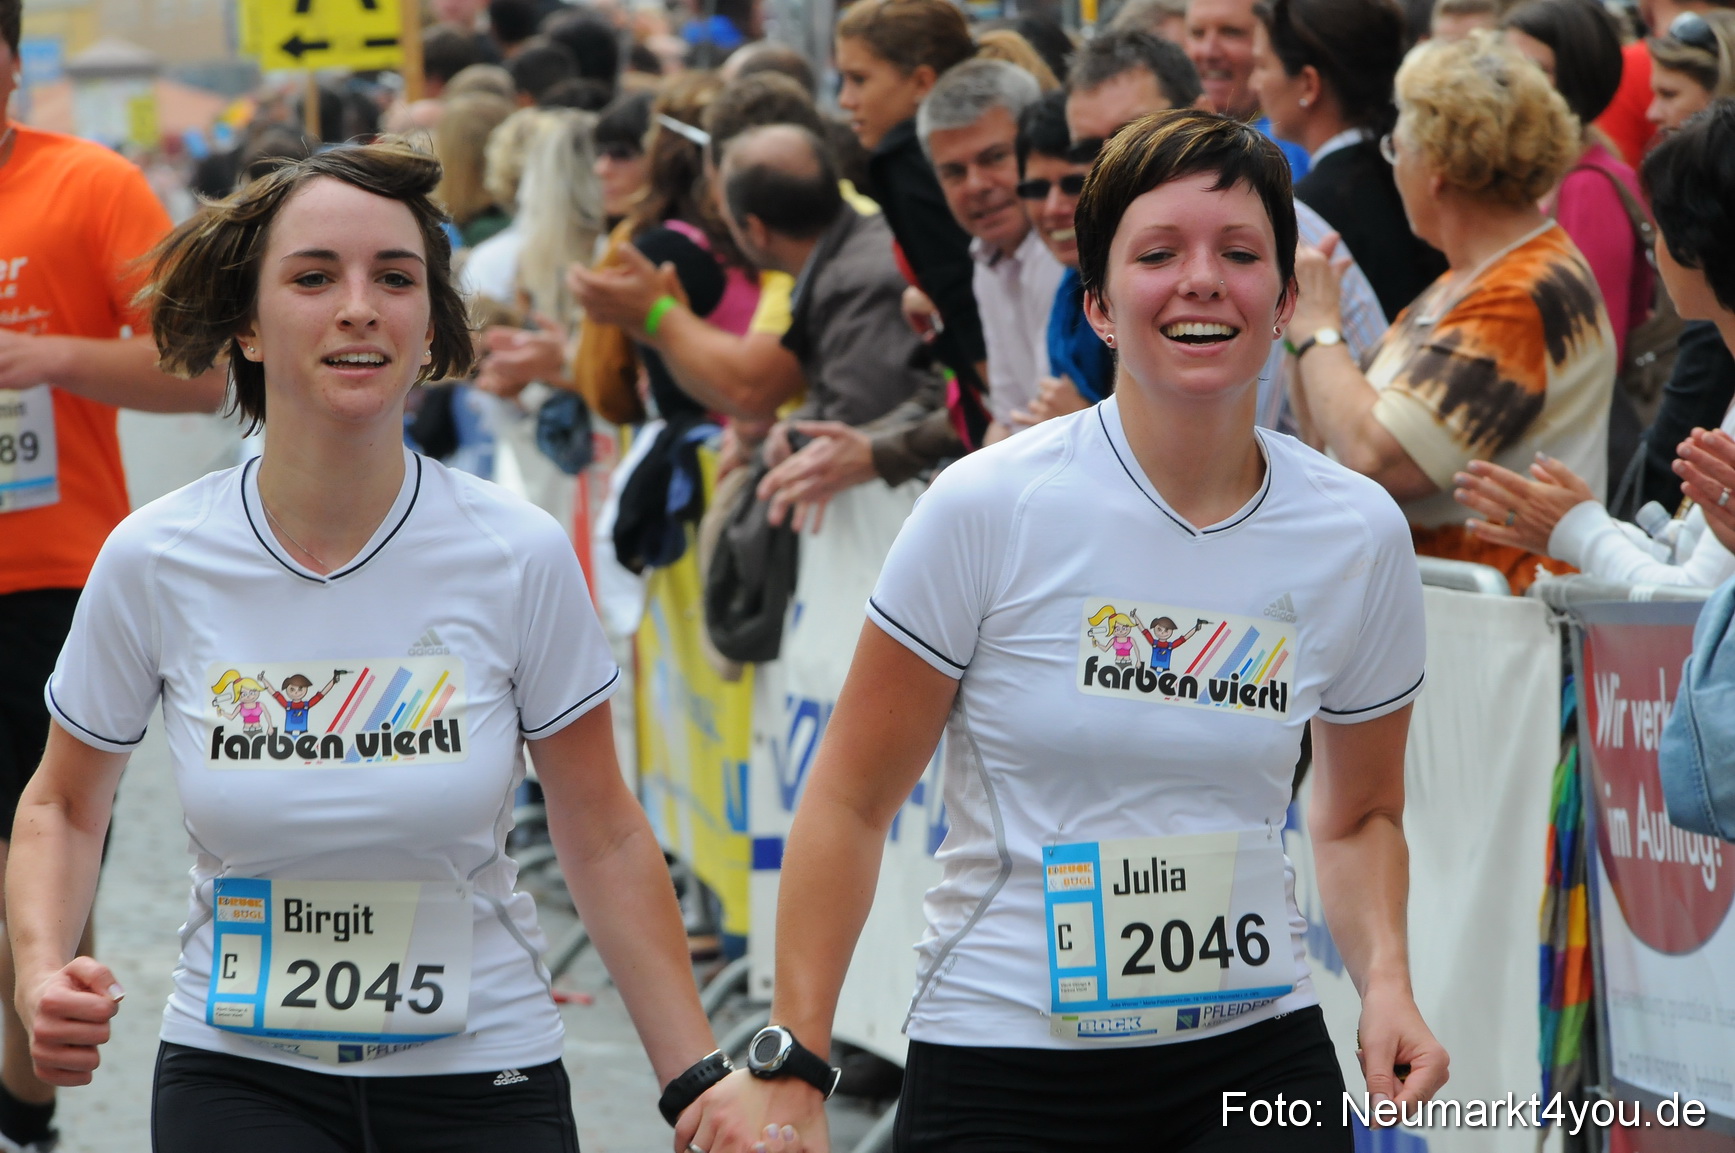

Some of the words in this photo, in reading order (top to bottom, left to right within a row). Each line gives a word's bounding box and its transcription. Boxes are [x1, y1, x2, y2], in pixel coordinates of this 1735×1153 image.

[1263, 607, 1298, 624] adidas
[407, 646, 450, 656] adidas
[1084, 656, 1198, 699] farben
[1208, 673, 1288, 713] viertl
[1593, 672, 1627, 749] Wir
[211, 725, 344, 760] farben
[356, 719, 462, 757] viertl
[1605, 782, 1632, 858] im
[1113, 857, 1187, 896] Julia
[283, 898, 374, 942] Birgit
[1057, 923, 1073, 951] C
[1120, 913, 1271, 976] 2046
[222, 953, 238, 979] C
[280, 959, 446, 1015] 2045
[493, 1074, 529, 1086] adidas
